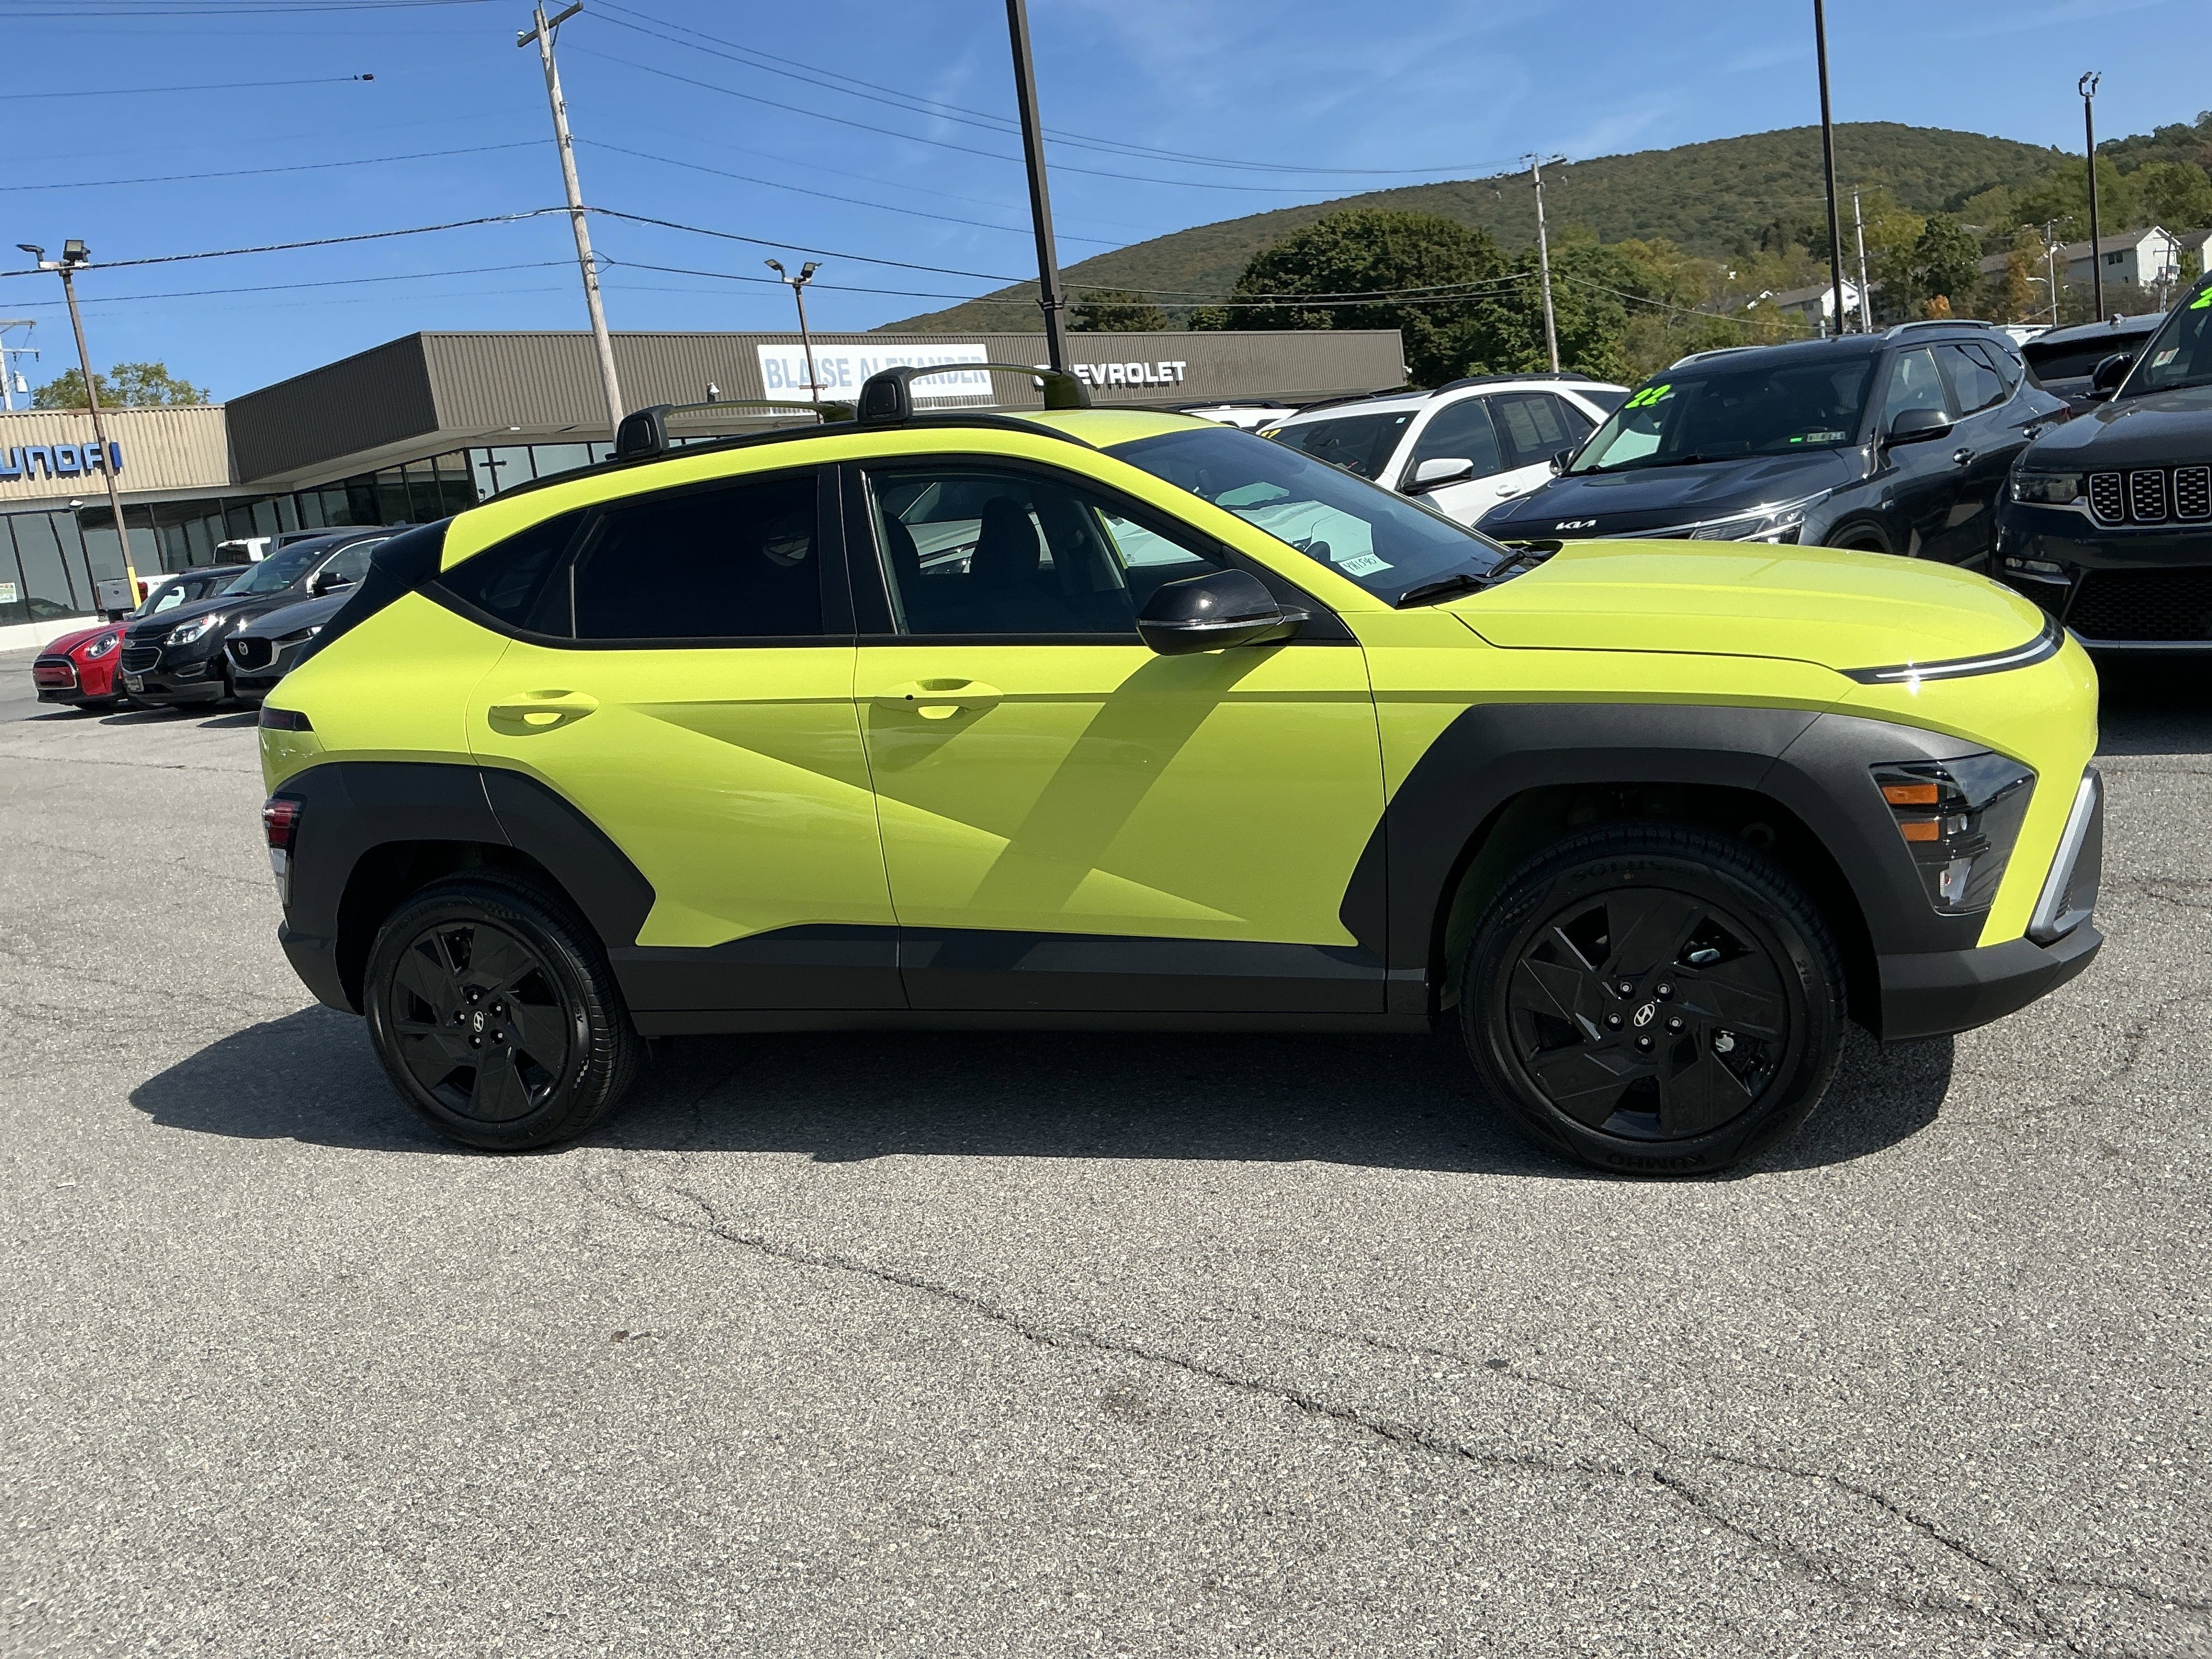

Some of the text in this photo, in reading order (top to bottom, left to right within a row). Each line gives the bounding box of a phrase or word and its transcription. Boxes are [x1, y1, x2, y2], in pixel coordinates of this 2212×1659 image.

[764, 358, 853, 388] BLAISE
[1624, 385, 1672, 409] 22
[1555, 519, 1598, 530] KIA
[1606, 1153, 1706, 1170] KUMHO
